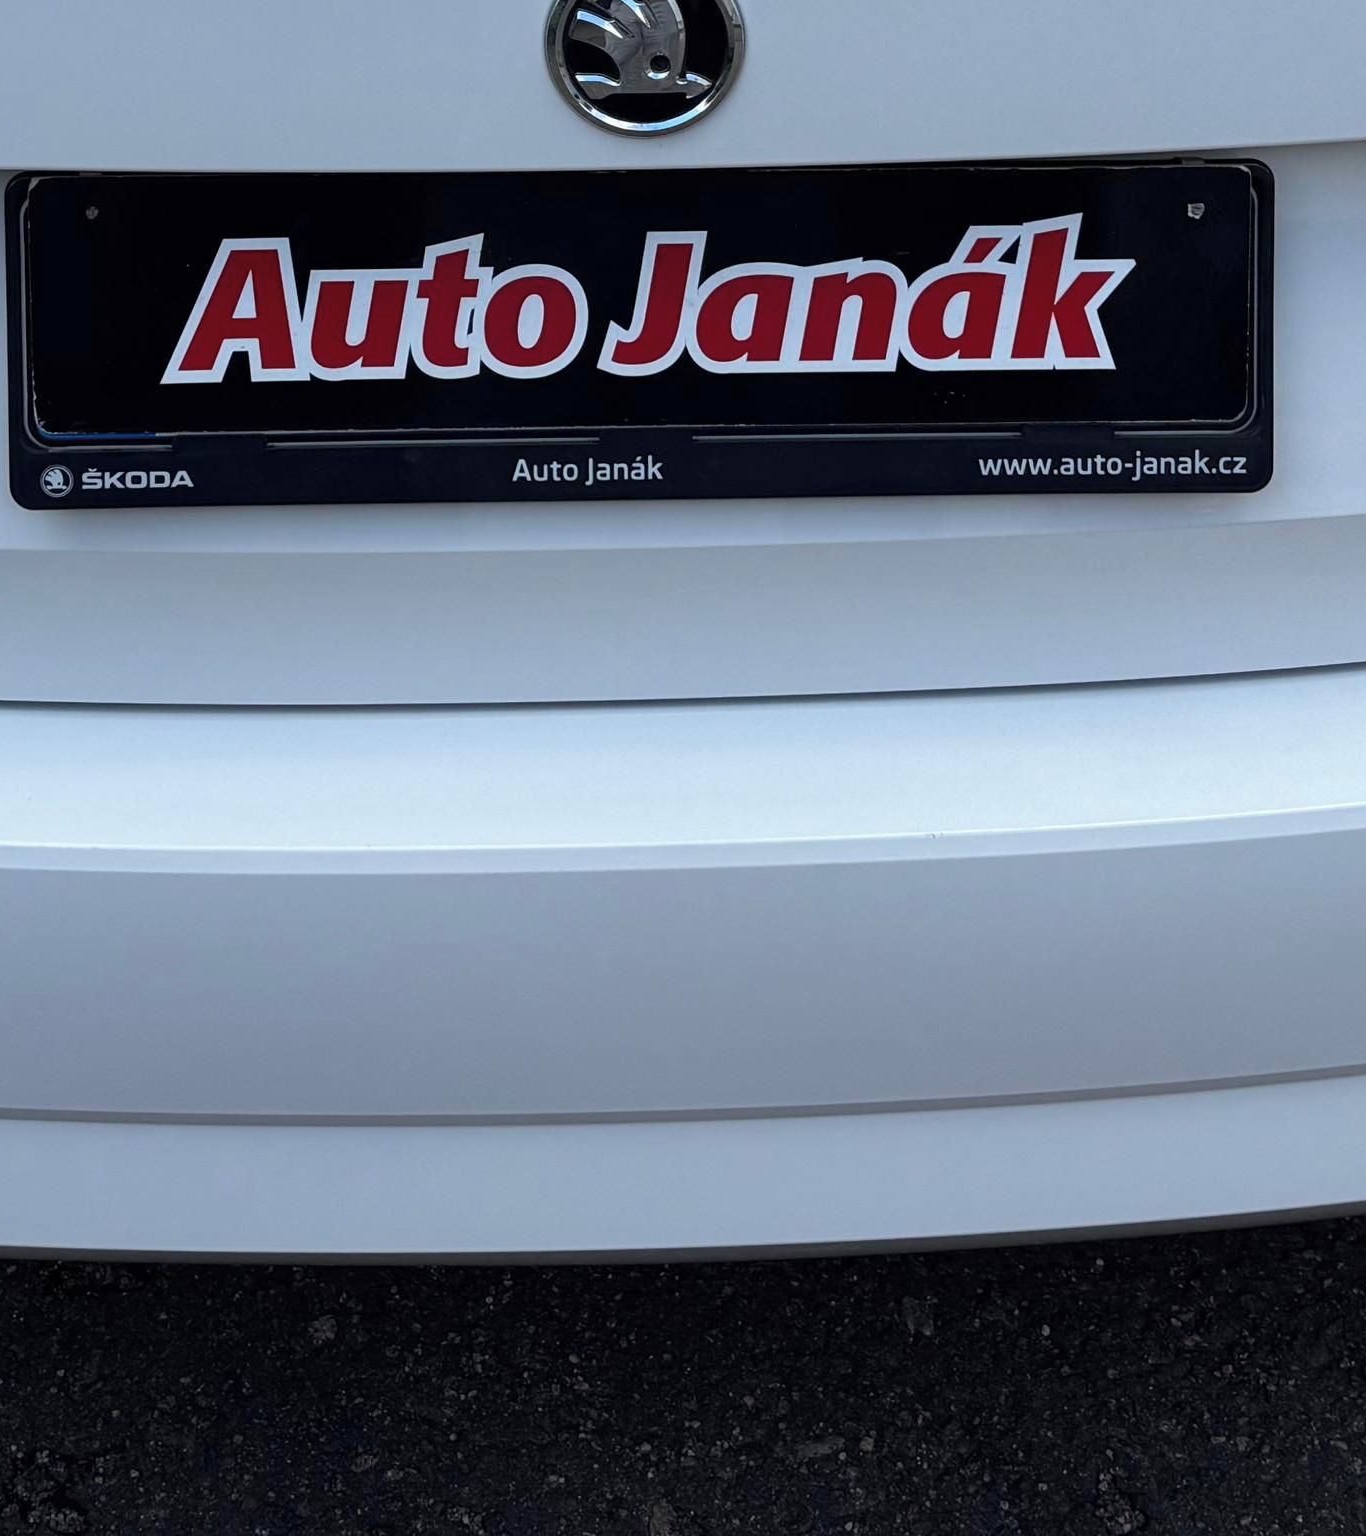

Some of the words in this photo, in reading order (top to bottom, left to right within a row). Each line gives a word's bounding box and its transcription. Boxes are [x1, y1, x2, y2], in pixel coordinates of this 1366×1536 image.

[160, 233, 589, 384] Auto
[597, 213, 1137, 376] Janák
[81, 468, 194, 490] ŠKODA
[512, 458, 579, 482] Auto
[585, 455, 664, 486] Janák
[978, 449, 1247, 481] www.auto-janak.cz
